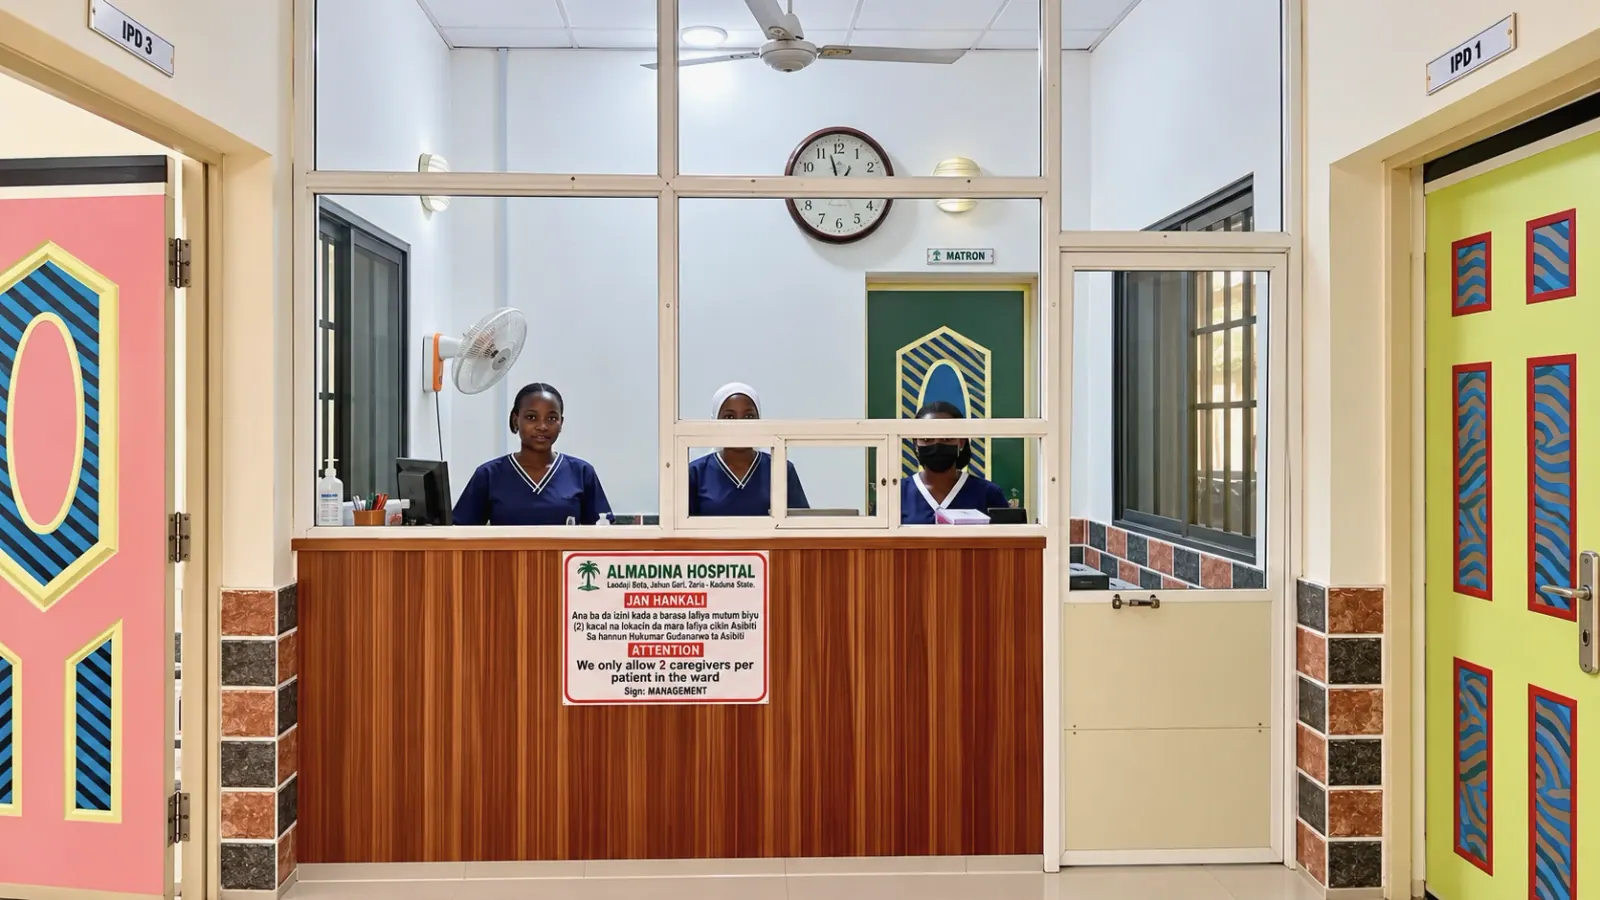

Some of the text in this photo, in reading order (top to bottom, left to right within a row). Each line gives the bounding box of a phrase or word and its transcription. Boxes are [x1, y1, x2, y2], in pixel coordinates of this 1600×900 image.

[122, 20, 152, 55] IPD 3
[1450, 40, 1481, 74] IPD 1
[817, 148, 825, 159] 11
[834, 142, 845, 154] 12
[804, 162, 814, 172] 10
[867, 162, 874, 173] 2
[805, 200, 812, 210] 8
[866, 200, 873, 211] 4
[818, 213, 825, 224] 7
[836, 218, 842, 228] 6
[854, 213, 860, 224] 5
[946, 251, 985, 260] MATRON
[607, 564, 755, 579] ALMADINA HOSPITAL
[627, 595, 704, 606] JAN HANKALI
[572, 611, 588, 620] Ana
[590, 611, 599, 620] ba
[602, 611, 611, 620] da
[614, 611, 630, 619] izini
[632, 611, 651, 619] kada
[660, 611, 686, 619] barasa
[689, 611, 710, 621] lafiya
[742, 611, 759, 621] biyu
[574, 622, 584, 632] (2)
[586, 622, 607, 630] kacal
[622, 622, 650, 630] lokacin
[652, 622, 662, 630] da
[686, 622, 708, 632] lafiya
[710, 622, 729, 630] cikin
[731, 621, 756, 630] Asibiti
[586, 632, 744, 640] Sa hannun Hukumar Gudanarwa ta Asibiti
[632, 645, 699, 655] ATTENTION
[577, 660, 754, 672] We only allow 2 caregivers per
[611, 671, 719, 684] patient in the ward
[624, 686, 707, 697] Sign: MANAGEMENT
